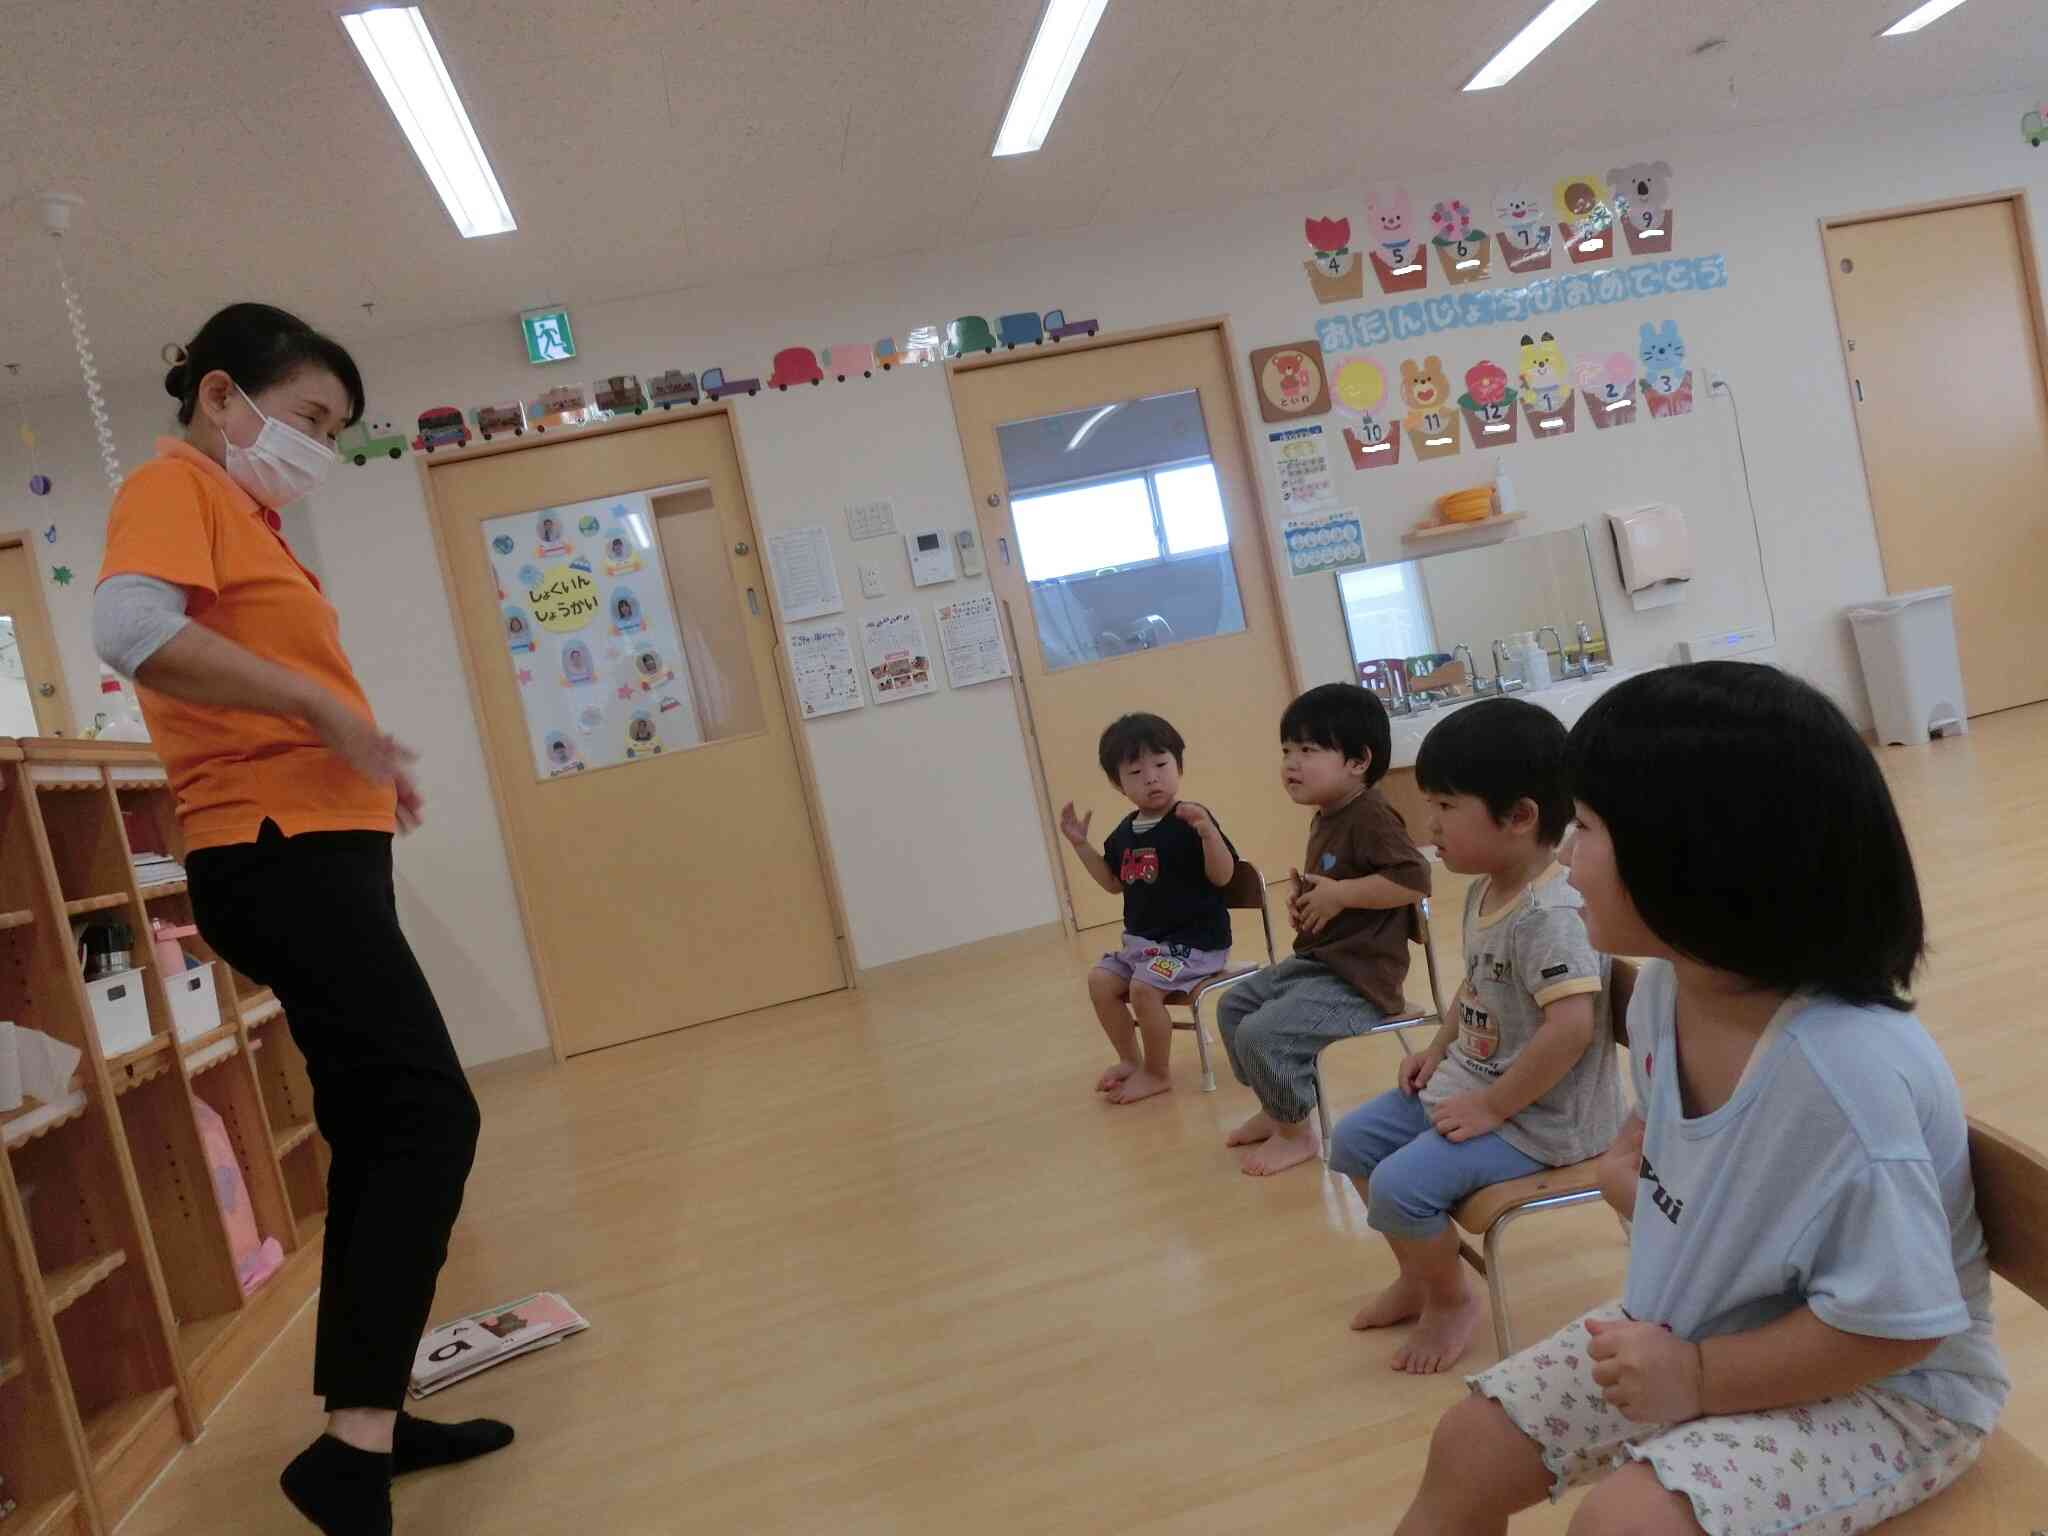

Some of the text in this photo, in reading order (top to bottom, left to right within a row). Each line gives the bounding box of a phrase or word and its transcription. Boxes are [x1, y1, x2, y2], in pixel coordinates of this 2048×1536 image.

[1640, 211, 1653, 229] 9
[1517, 230, 1530, 247] 7
[1393, 247, 1405, 263] 5
[1456, 241, 1468, 257] 6
[1328, 255, 1341, 273] 4
[1605, 382, 1619, 398] 2
[1659, 374, 1673, 391] 3
[1483, 404, 1501, 420] 12
[1424, 413, 1441, 431] 11
[1363, 424, 1382, 442] 10
[529, 574, 591, 604] しょくいん
[534, 596, 599, 623] しょうかい
